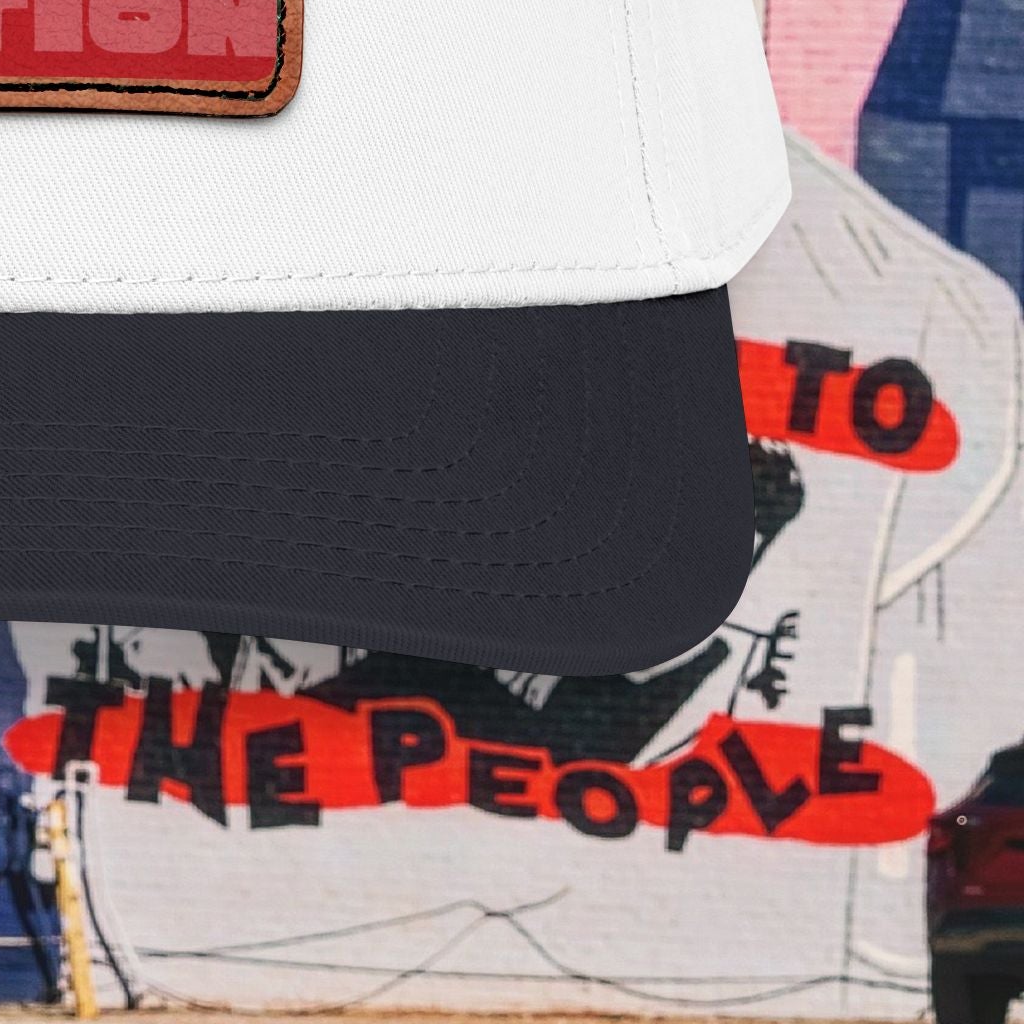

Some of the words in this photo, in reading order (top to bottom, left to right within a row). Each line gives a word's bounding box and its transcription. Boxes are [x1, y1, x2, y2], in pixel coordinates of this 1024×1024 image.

[785, 340, 932, 453] TO
[45, 676, 321, 828] THE
[372, 707, 882, 852] PEOPLE
